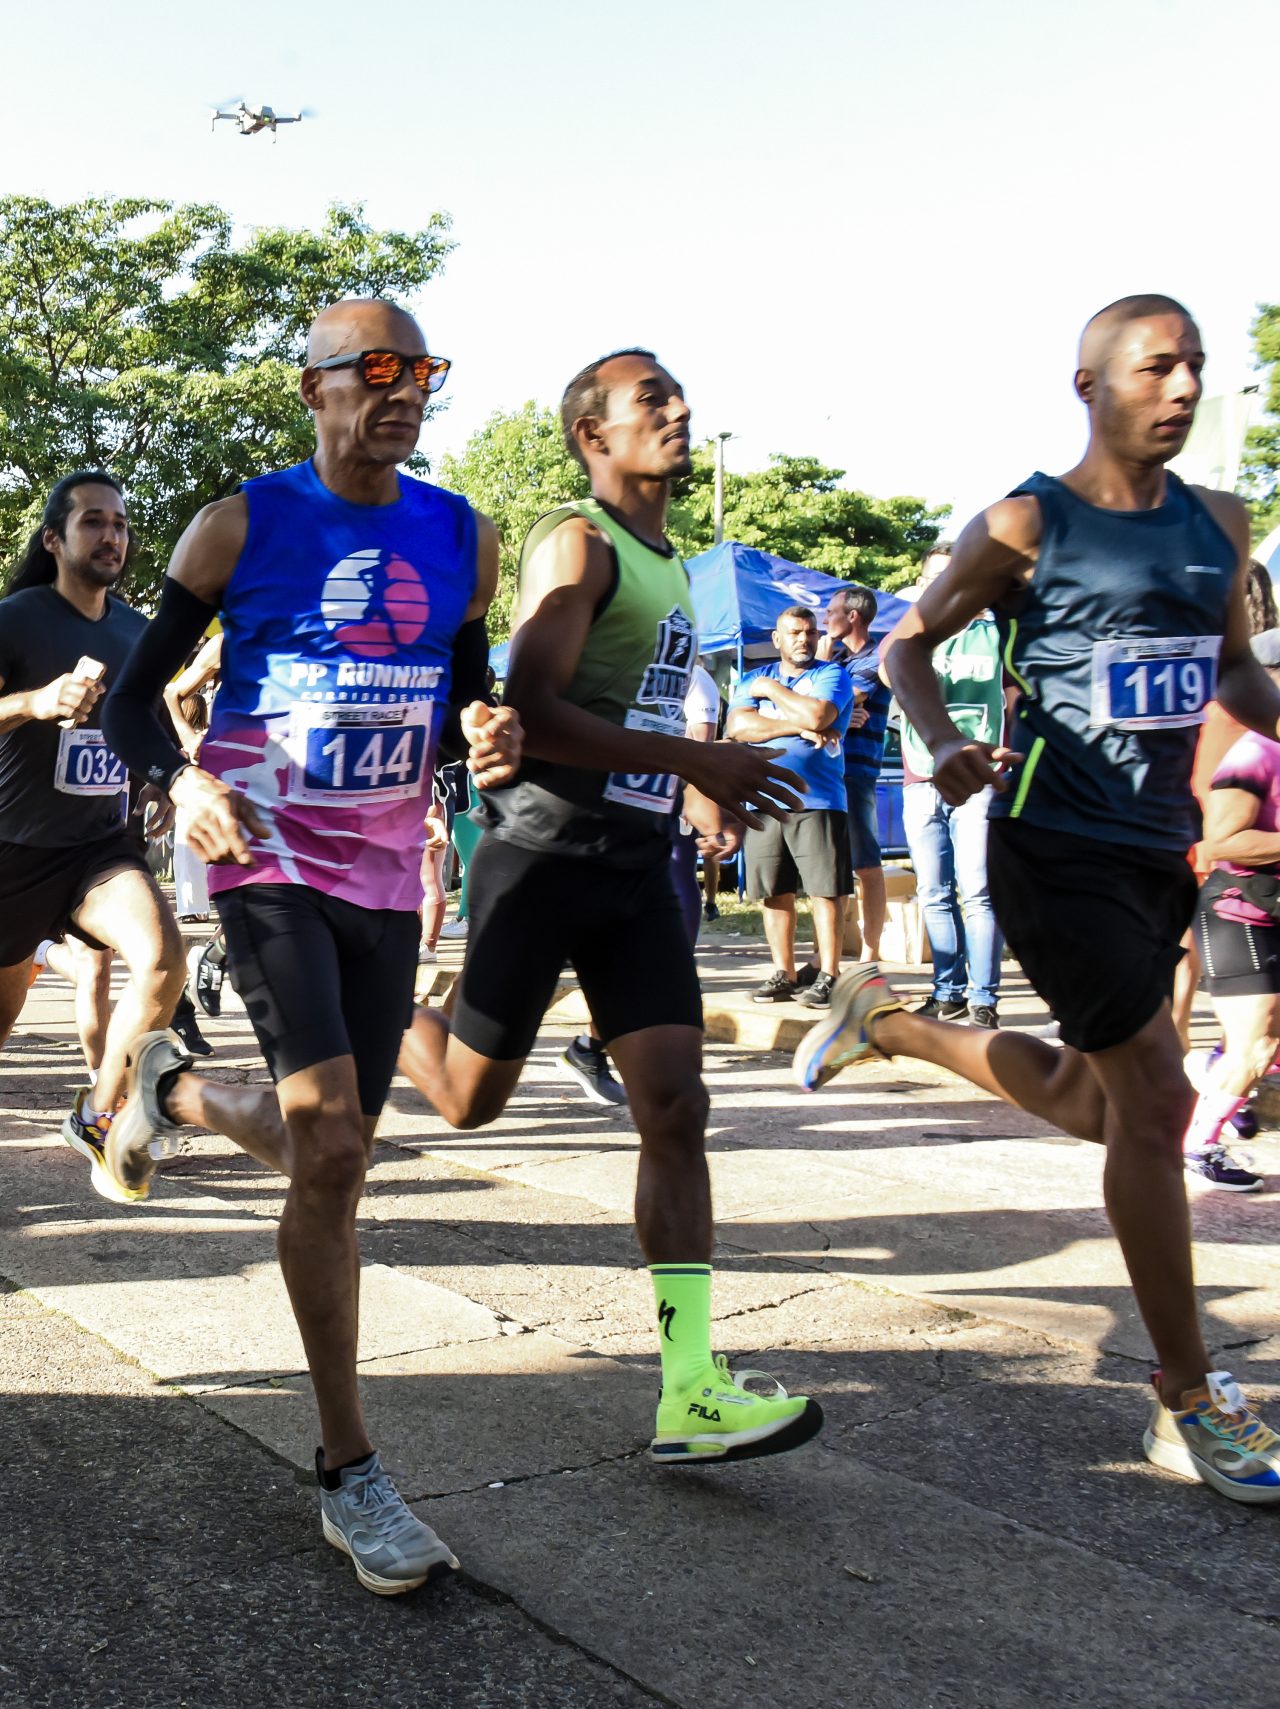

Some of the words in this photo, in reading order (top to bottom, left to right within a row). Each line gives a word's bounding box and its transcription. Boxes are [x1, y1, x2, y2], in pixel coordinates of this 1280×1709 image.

[288, 662, 328, 687] PP
[1124, 663, 1205, 715] 119
[323, 711, 367, 720] STREET
[371, 711, 401, 720] RACE
[76, 748, 122, 784] 032
[322, 730, 414, 787] 144
[687, 1402, 721, 1423] FILA
